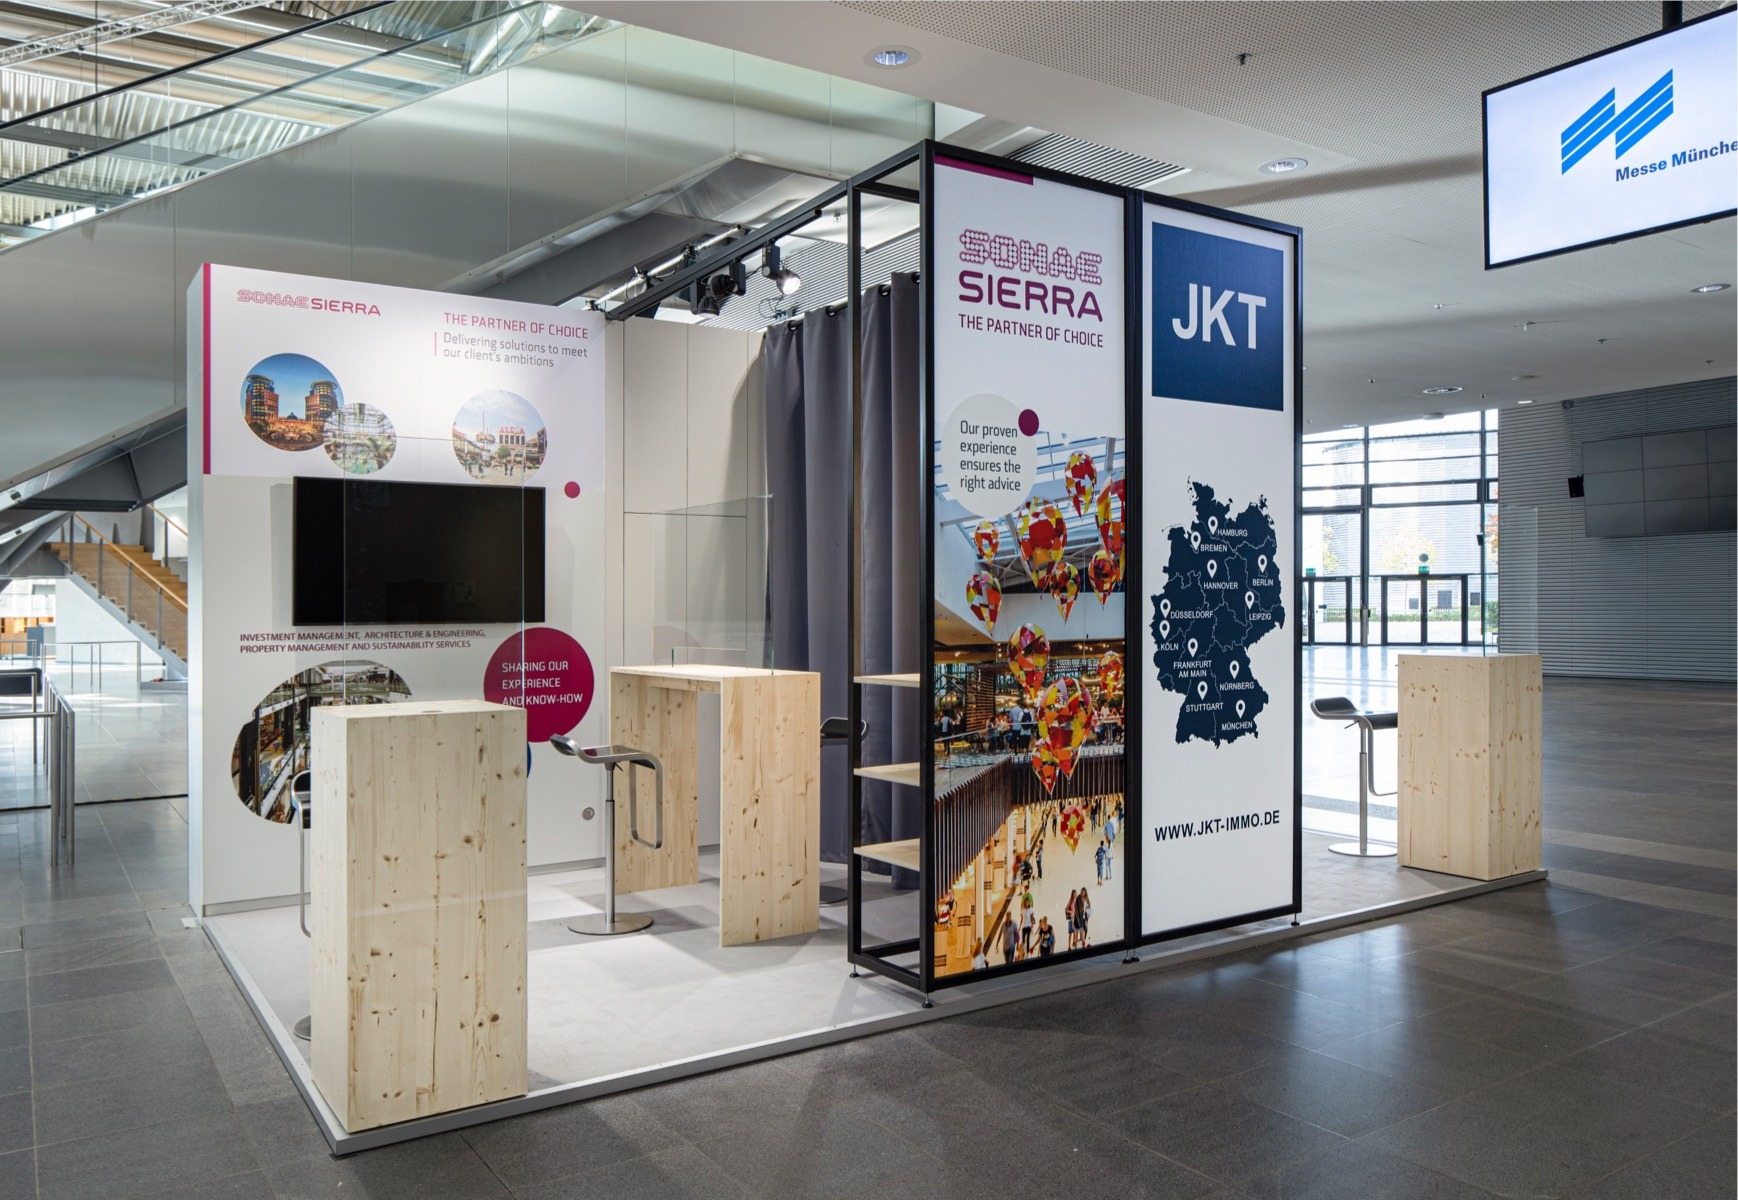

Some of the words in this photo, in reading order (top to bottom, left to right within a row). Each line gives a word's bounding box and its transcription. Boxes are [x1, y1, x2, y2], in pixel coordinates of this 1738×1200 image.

[1616, 160, 1667, 182] Messe
[959, 229, 1102, 285] SONAE
[958, 270, 1103, 322] SIERRA
[311, 298, 381, 316] SIERRA
[1172, 283, 1267, 350] JKT
[444, 312, 467, 326] THE
[471, 315, 526, 332] PARTNER
[530, 322, 545, 334] OF
[548, 324, 588, 339] CHOICE
[958, 313, 983, 331] THE
[987, 317, 1042, 339] PARTNER
[1046, 326, 1060, 341] OF
[1064, 329, 1103, 348] CHOICE
[444, 332, 497, 351] Delivering
[500, 339, 545, 353] solutions
[548, 345, 558, 354] to
[562, 348, 588, 358] meet
[444, 349, 461, 358] our
[465, 349, 500, 362] client's
[504, 353, 554, 367] ambitions
[960, 420, 979, 434] Our
[983, 425, 1018, 439] proven
[960, 441, 1017, 456] experience
[960, 459, 1001, 472] ensures
[1004, 459, 1020, 473] the
[960, 474, 985, 492] right
[988, 476, 1020, 491] advice
[1217, 529, 1248, 537] HAMBURG
[1200, 544, 1227, 552] BREMEN
[1203, 582, 1238, 590] HANNOVER
[1252, 578, 1273, 586] BERLIN
[1170, 609, 1214, 619] DÜSSELDORF
[1249, 612, 1271, 621] LEIPZIG
[240, 633, 296, 641] INVESTMENT
[364, 630, 423, 639] ARCHITECTURE
[425, 630, 431, 638] &
[433, 629, 486, 638] ENGINEERING,
[240, 645, 286, 653] PROPERTY
[287, 643, 350, 652] MANAGEMENT
[351, 642, 370, 651] AND
[372, 641, 434, 650] SUSTAINABILITY
[436, 640, 471, 648] SERVICES
[1160, 641, 1179, 651] KÖLN
[502, 661, 545, 672] SHARING
[548, 661, 568, 671] OUR
[1173, 660, 1212, 669] FRANKFURT
[1178, 670, 1188, 678] AM
[1190, 669, 1207, 678] MAIN
[502, 678, 561, 689] EXPERIENCE
[1219, 680, 1254, 691] NÜRNBERG
[502, 696, 523, 706] AND
[526, 693, 583, 706] KNOW-HOW
[1185, 702, 1224, 712] STUTTGART
[1221, 720, 1253, 731] MÜNCHEN
[1154, 810, 1280, 842] WWW.JKT-IMMO.DE
